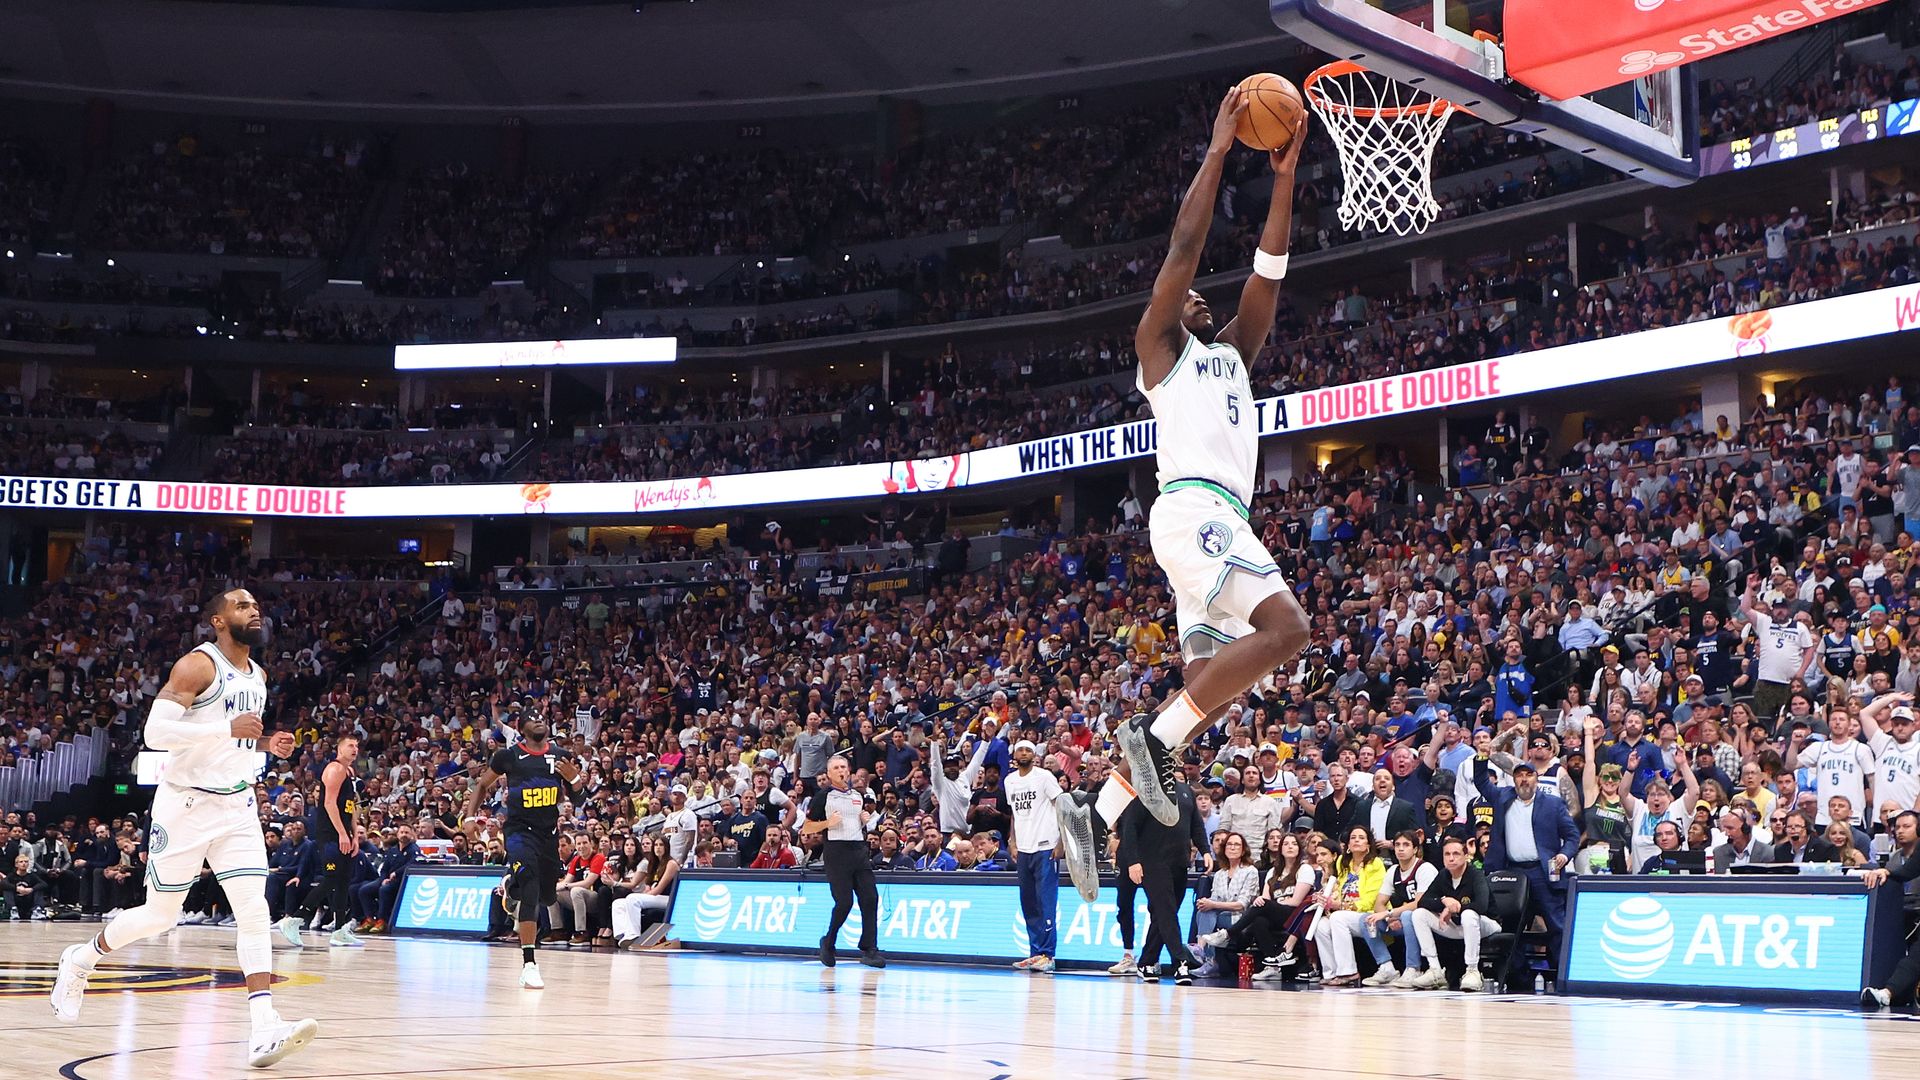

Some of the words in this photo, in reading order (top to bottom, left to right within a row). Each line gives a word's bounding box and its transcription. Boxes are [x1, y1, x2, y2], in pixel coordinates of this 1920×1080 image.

[1679, 8, 1807, 55] State
[1733, 151, 1751, 169] 33
[1867, 123, 1878, 139] 3
[1274, 398, 1289, 430] A
[1302, 380, 1393, 426] DOUBLE
[1401, 361, 1500, 409] DOUBLE
[1226, 391, 1240, 428] 5
[1018, 436, 1074, 473] WHEN
[1080, 428, 1116, 462] THE
[76, 481, 120, 507] GET
[126, 483, 142, 508] A
[156, 484, 249, 512] DOUBLE
[255, 488, 346, 514] DOUBLE
[634, 481, 690, 512] Wendy's
[1769, 631, 1797, 642] WOLVES
[1775, 638, 1784, 649] 5
[1702, 653, 1710, 666] 5
[1837, 658, 1845, 668] 5
[698, 689, 710, 698] 32
[1820, 758, 1854, 774] WOLVES
[1882, 756, 1913, 775] WOLVES
[1887, 769, 1896, 783] 5
[1832, 773, 1840, 786] 5
[522, 786, 558, 809] 5280
[1011, 790, 1037, 803] WOLVES
[1015, 801, 1032, 812] BACK
[436, 887, 493, 920] AT&T
[731, 896, 807, 934] AT&T
[884, 899, 971, 940] AT&T
[1682, 913, 1835, 969] AT&T
